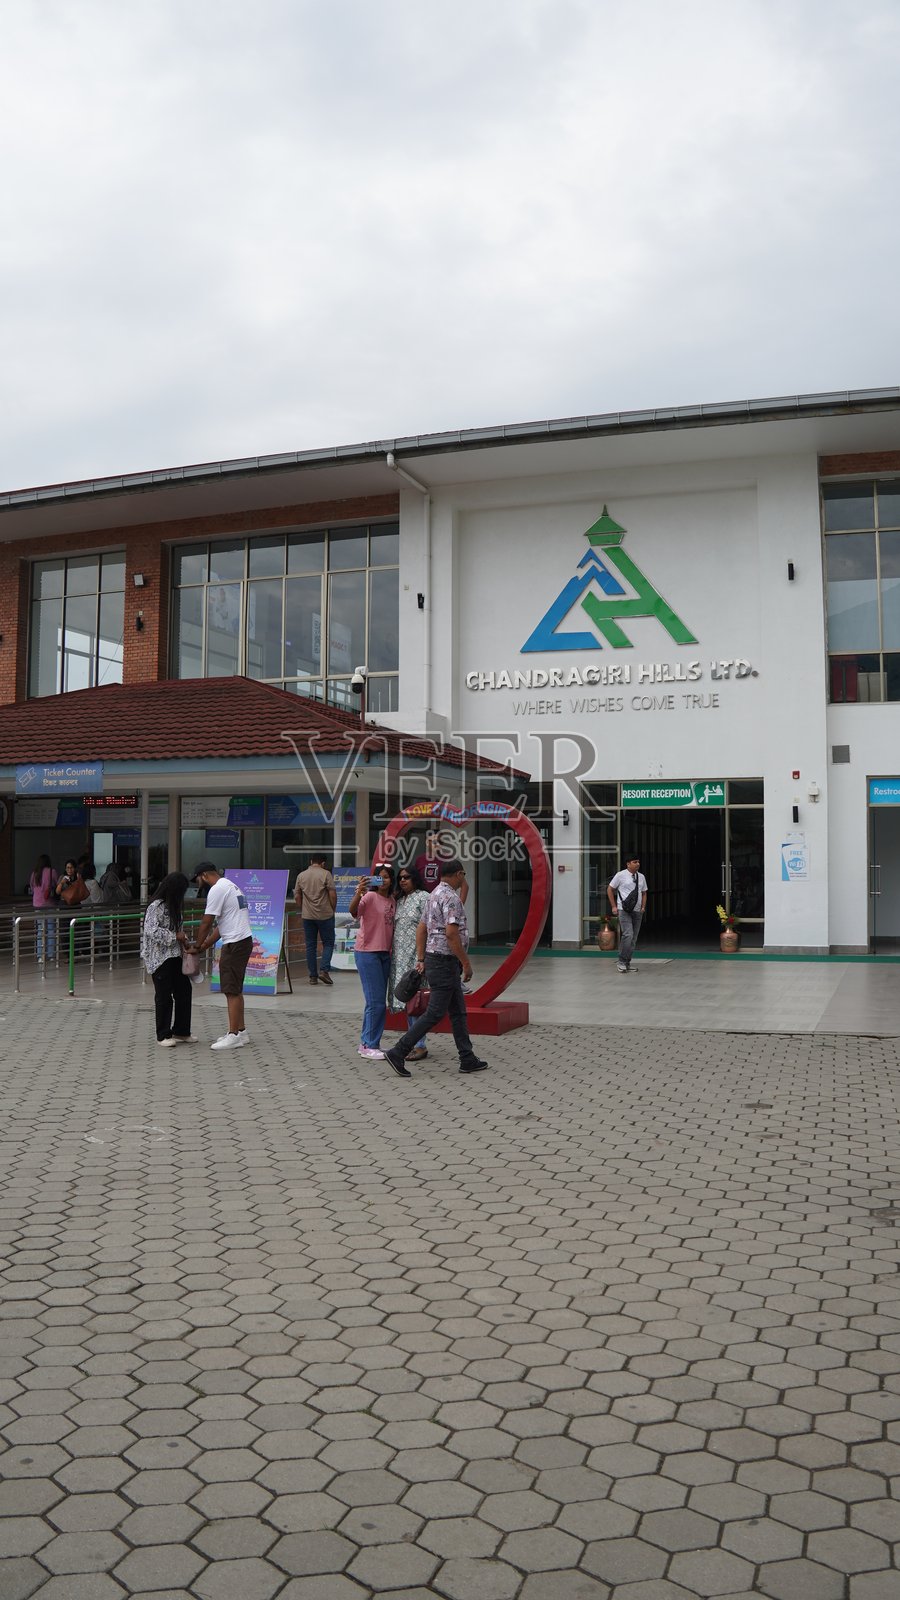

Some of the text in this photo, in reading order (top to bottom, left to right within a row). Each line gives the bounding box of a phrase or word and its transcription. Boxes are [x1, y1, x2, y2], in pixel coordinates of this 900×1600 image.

[465, 658, 759, 690] CHANDRAGIRI HILLS LTD.
[512, 693, 720, 716] WHERE WISHES COME TRUE
[43, 767, 97, 777] Ticket Counter
[622, 788, 691, 798] RESORT RECEPTION
